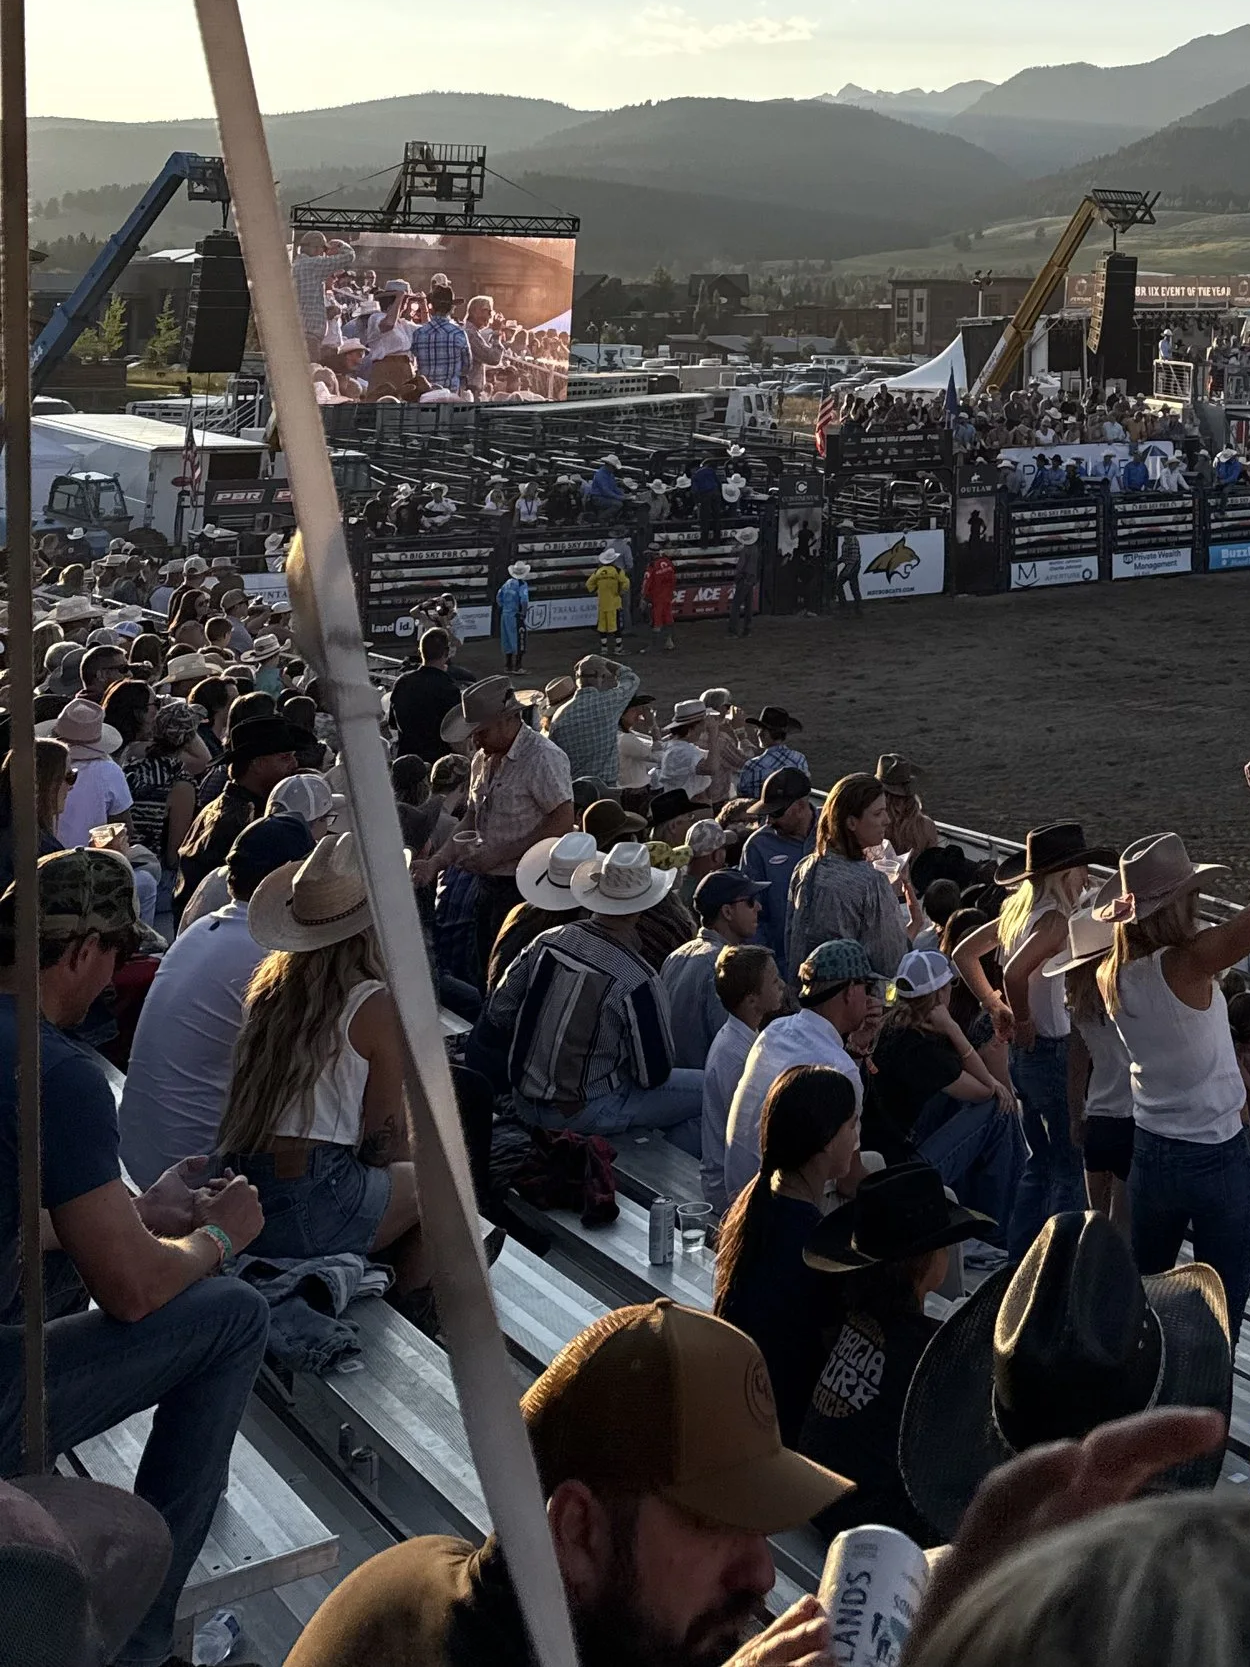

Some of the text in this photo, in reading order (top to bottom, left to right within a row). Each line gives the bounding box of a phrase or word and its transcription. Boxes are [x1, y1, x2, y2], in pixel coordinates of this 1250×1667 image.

[1134, 286, 1146, 296] BR
[1161, 286, 1185, 296] EVENT
[1186, 286, 1196, 296] OF
[960, 485, 992, 493] OUTLAW
[215, 492, 261, 502] PBR
[409, 550, 458, 560] BIG SKY PBR
[1134, 550, 1181, 561] Private Wealth
[1134, 560, 1177, 571] Management
[693, 587, 722, 602] ACE
